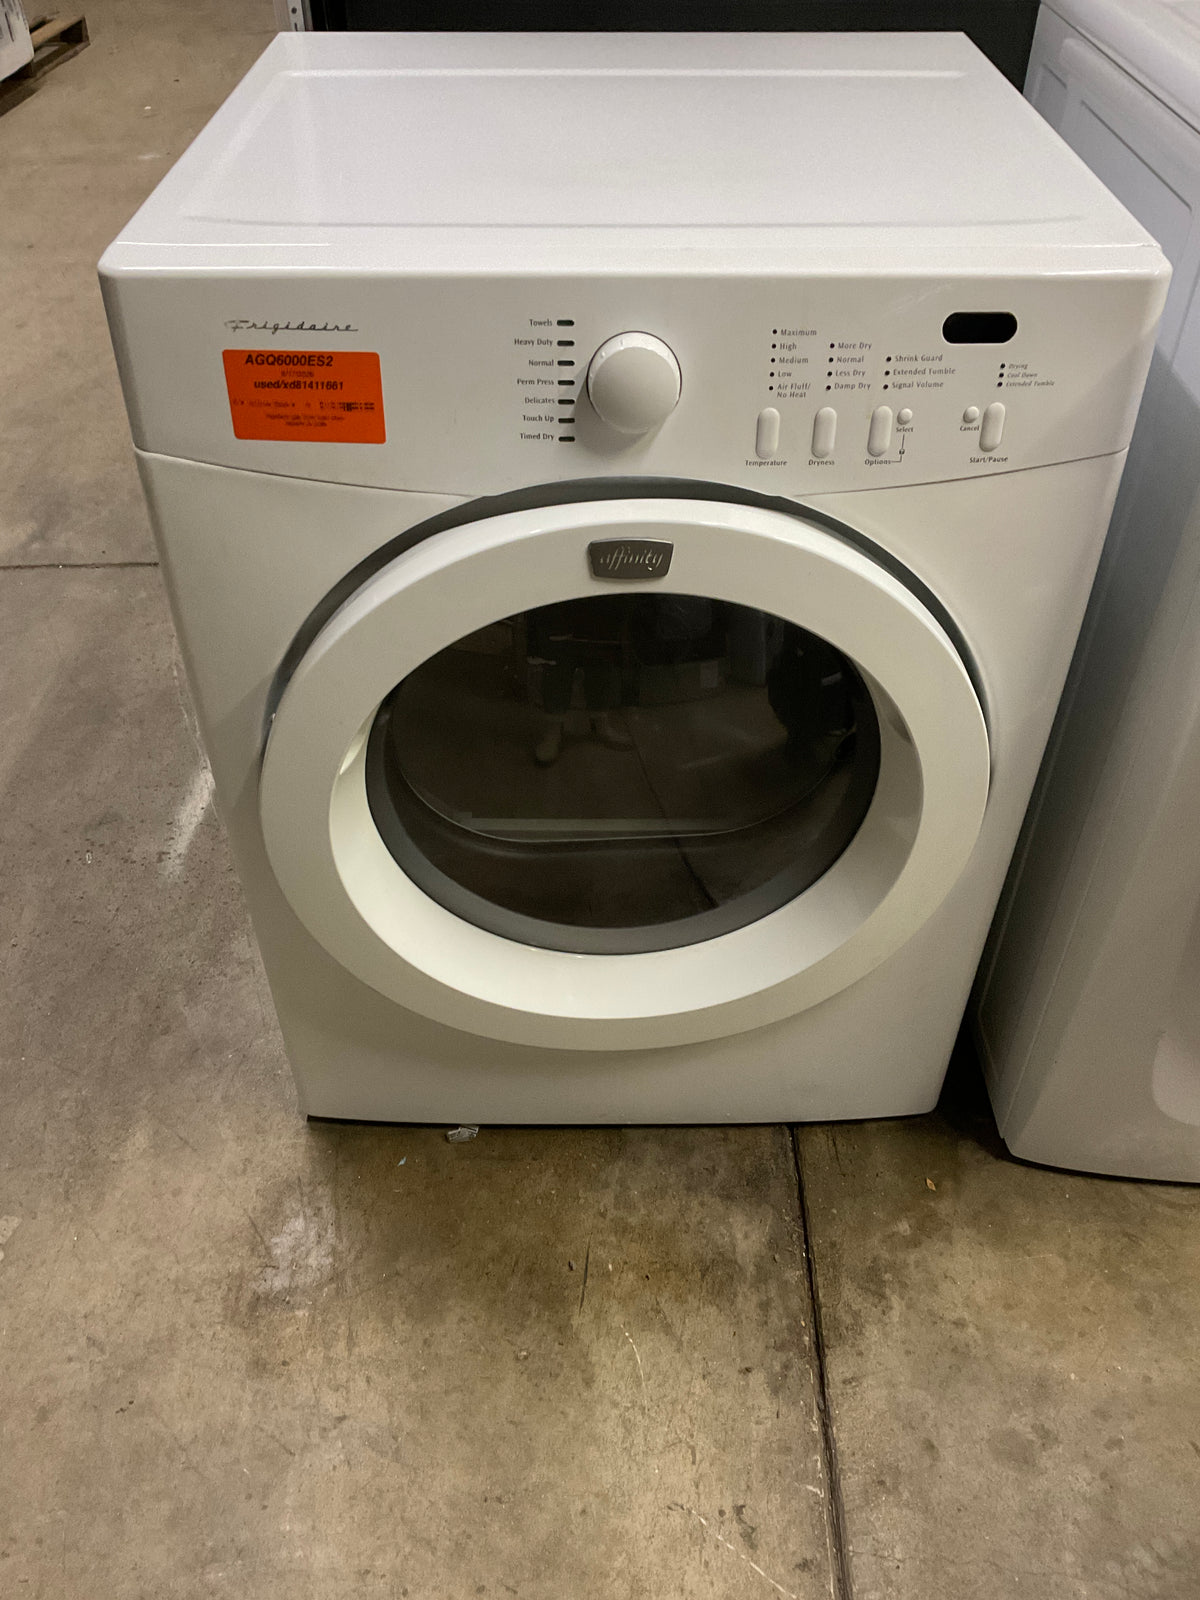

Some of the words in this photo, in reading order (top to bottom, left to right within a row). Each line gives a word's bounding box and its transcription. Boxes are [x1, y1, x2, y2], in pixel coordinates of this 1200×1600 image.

[529, 319, 553, 327] Towels
[224, 320, 359, 335] Frigidaire
[514, 338, 535, 346] Heavy
[537, 338, 553, 346] Duty
[859, 342, 872, 350] Dry
[779, 342, 797, 351] High
[245, 354, 334, 367] AGQ6000ES2
[895, 354, 919, 362] Shrink
[920, 354, 943, 362] Guard
[852, 369, 866, 377] Dry
[928, 367, 956, 375] Tumble
[790, 382, 811, 391] Fluff/
[834, 382, 856, 390] Damp
[857, 382, 871, 391] Dry
[892, 381, 914, 390] Signal
[916, 381, 944, 389] Volume
[544, 415, 554, 423] Up
[543, 433, 555, 441] Dry
[808, 459, 835, 467] Dryness
[864, 459, 891, 467] Options
[969, 456, 1009, 464] Start/Pause
[599, 545, 664, 571] affinity
